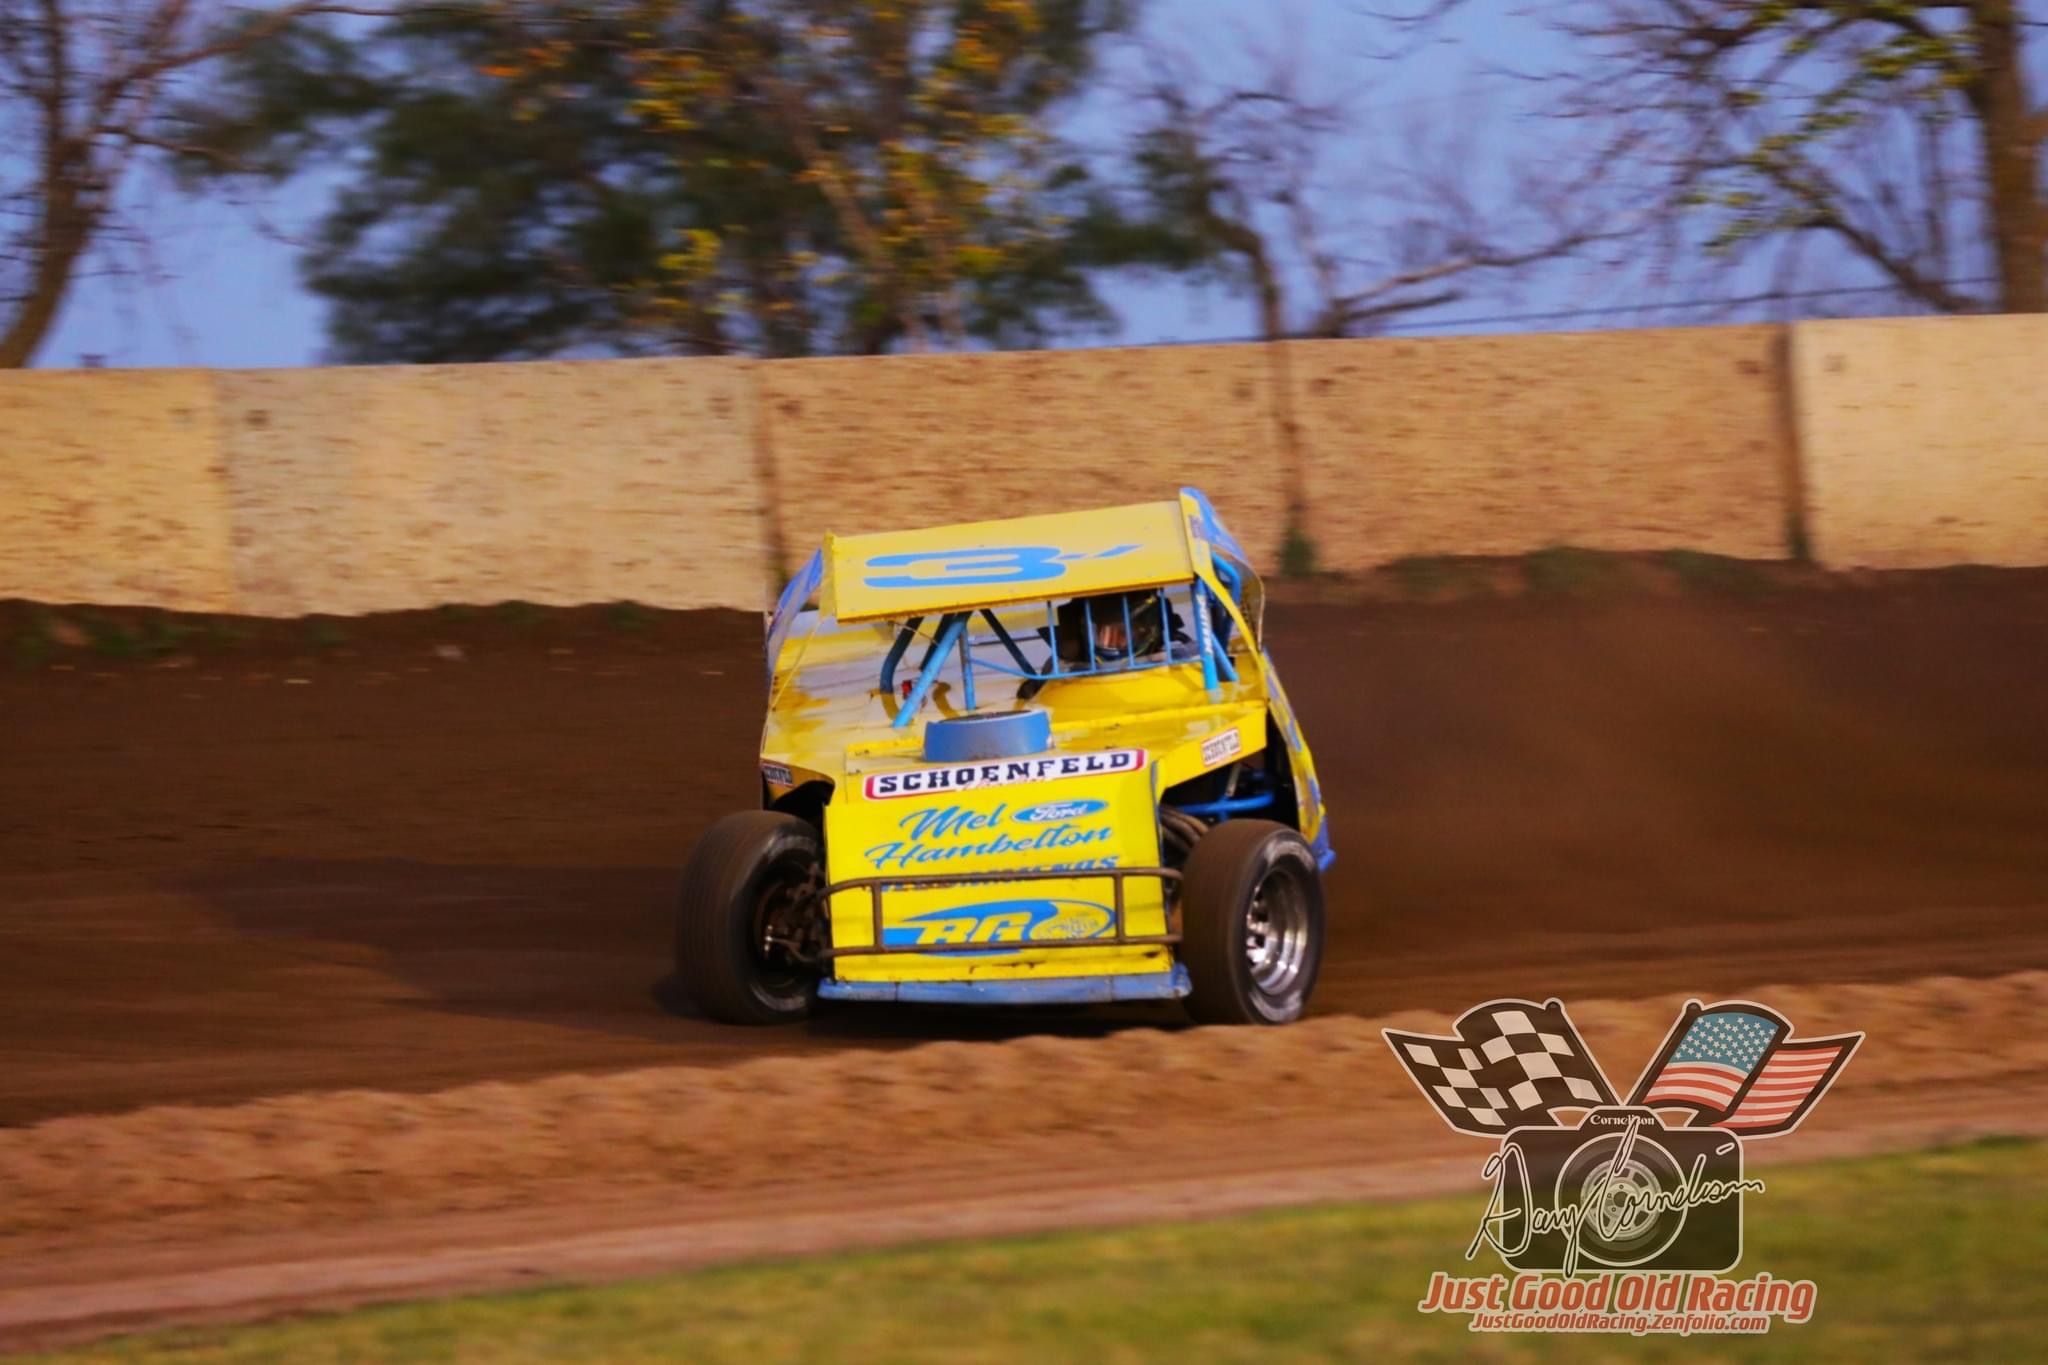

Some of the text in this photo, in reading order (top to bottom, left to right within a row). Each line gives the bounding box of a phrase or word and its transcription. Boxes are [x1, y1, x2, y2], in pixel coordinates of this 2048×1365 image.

[879, 753, 1131, 794] SCHOENFELD
[899, 803, 1008, 841] Mel
[1028, 804, 1090, 822] Ford
[864, 824, 1113, 869] Hambelton
